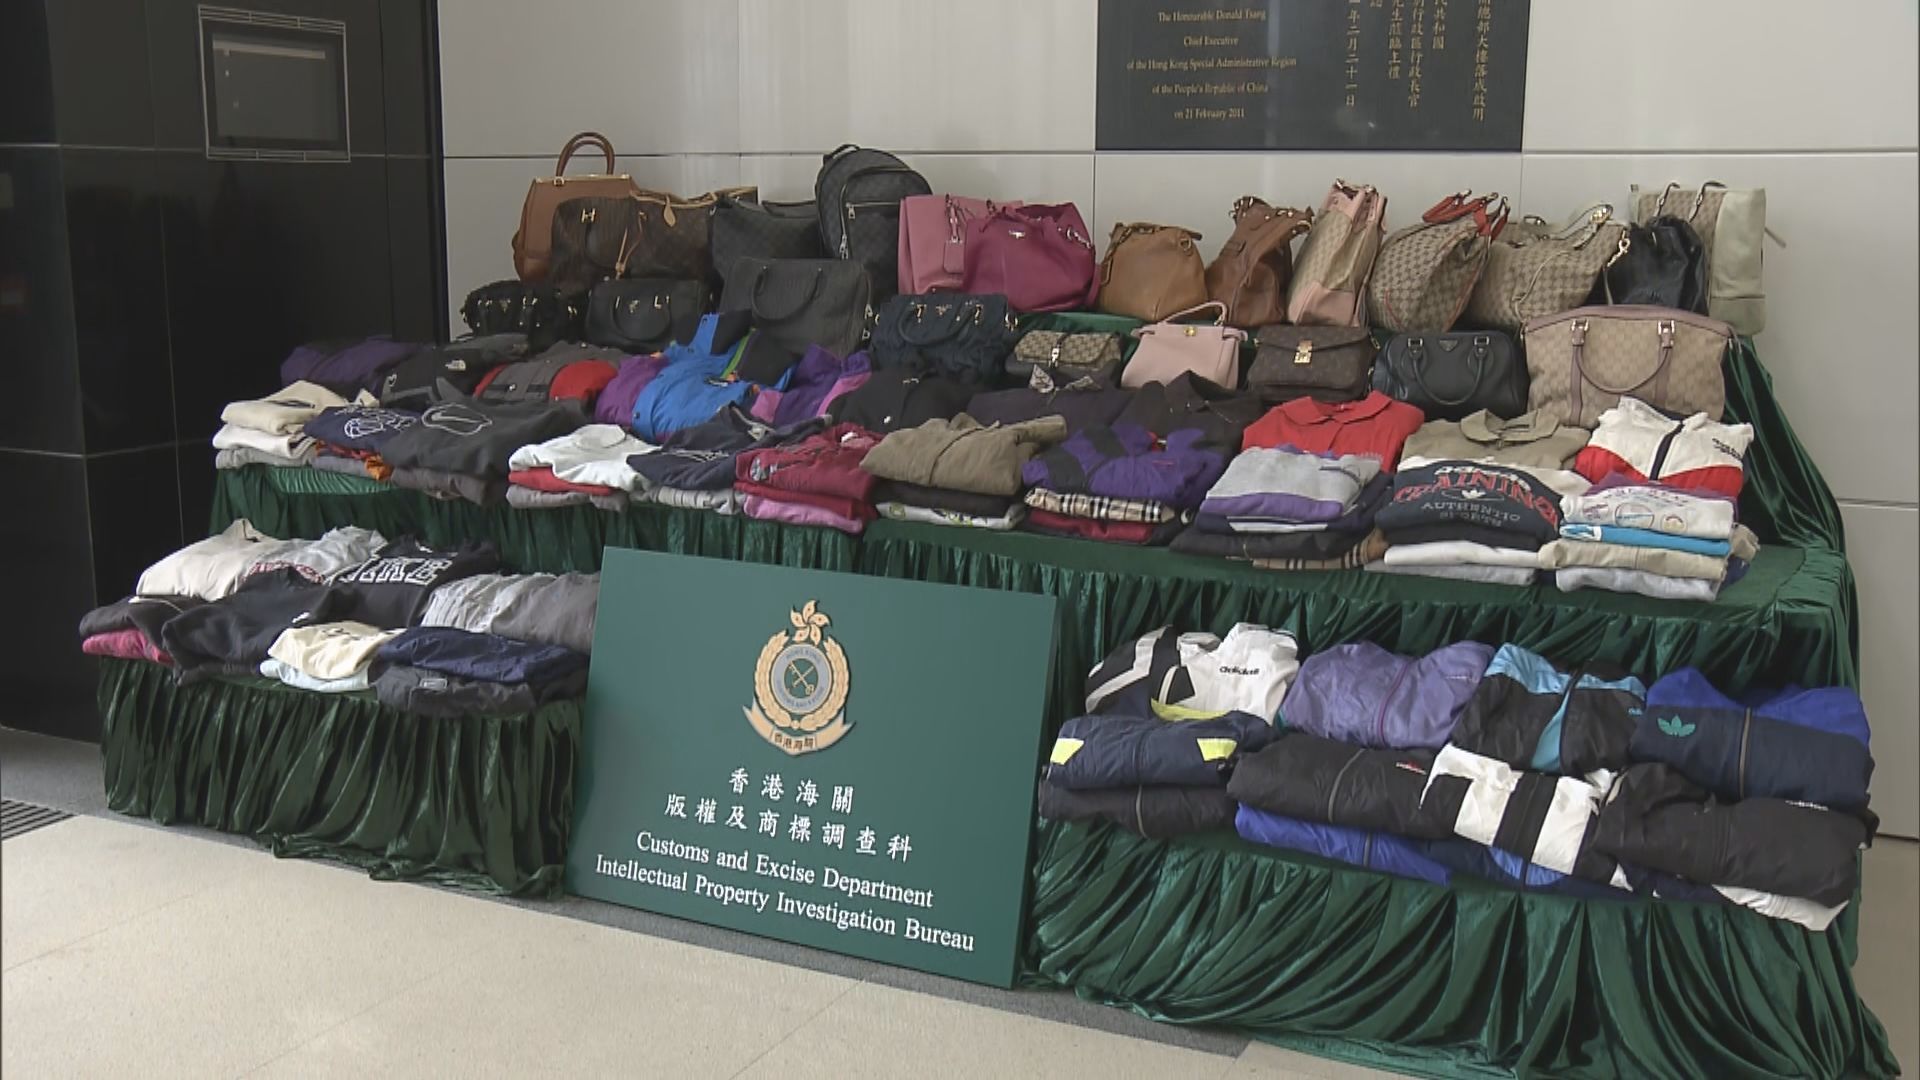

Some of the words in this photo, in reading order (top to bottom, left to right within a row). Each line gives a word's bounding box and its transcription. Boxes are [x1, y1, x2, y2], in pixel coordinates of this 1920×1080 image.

[1158, 11, 1170, 22] The
[1173, 10, 1215, 22] Honourable
[1216, 9, 1243, 20] Donald
[1245, 8, 1266, 21] Tsang
[1183, 35, 1203, 47] Chief
[1204, 35, 1240, 46] Executive
[1126, 58, 1135, 69] of
[1135, 58, 1148, 70] the
[1148, 59, 1168, 71] Hong
[1169, 58, 1189, 71] Kong
[1189, 57, 1214, 71] Special
[1216, 56, 1269, 68] Administrative
[1271, 56, 1297, 69] Region
[1152, 84, 1160, 94] of
[1161, 84, 1173, 94] the
[1174, 84, 1203, 96] People's
[1204, 83, 1234, 95] Republic
[1237, 82, 1246, 93] of
[1246, 82, 1269, 93] China
[1174, 110, 1183, 119] on
[1185, 108, 1193, 119] 21
[1195, 108, 1227, 120] February
[1229, 107, 1244, 118] 2011
[1421, 501, 1521, 521] AUTHENTIC
[729, 767, 854, 815] 香港海關
[664, 794, 913, 863] 版權及商標調查科
[637, 831, 710, 864] Customs
[716, 850, 749, 872] and
[755, 853, 816, 884] Excise
[822, 866, 934, 908] Department
[596, 854, 688, 892] Intellectual
[694, 874, 770, 913] Property
[776, 891, 896, 935] Investigation
[904, 917, 975, 951] Bureau
